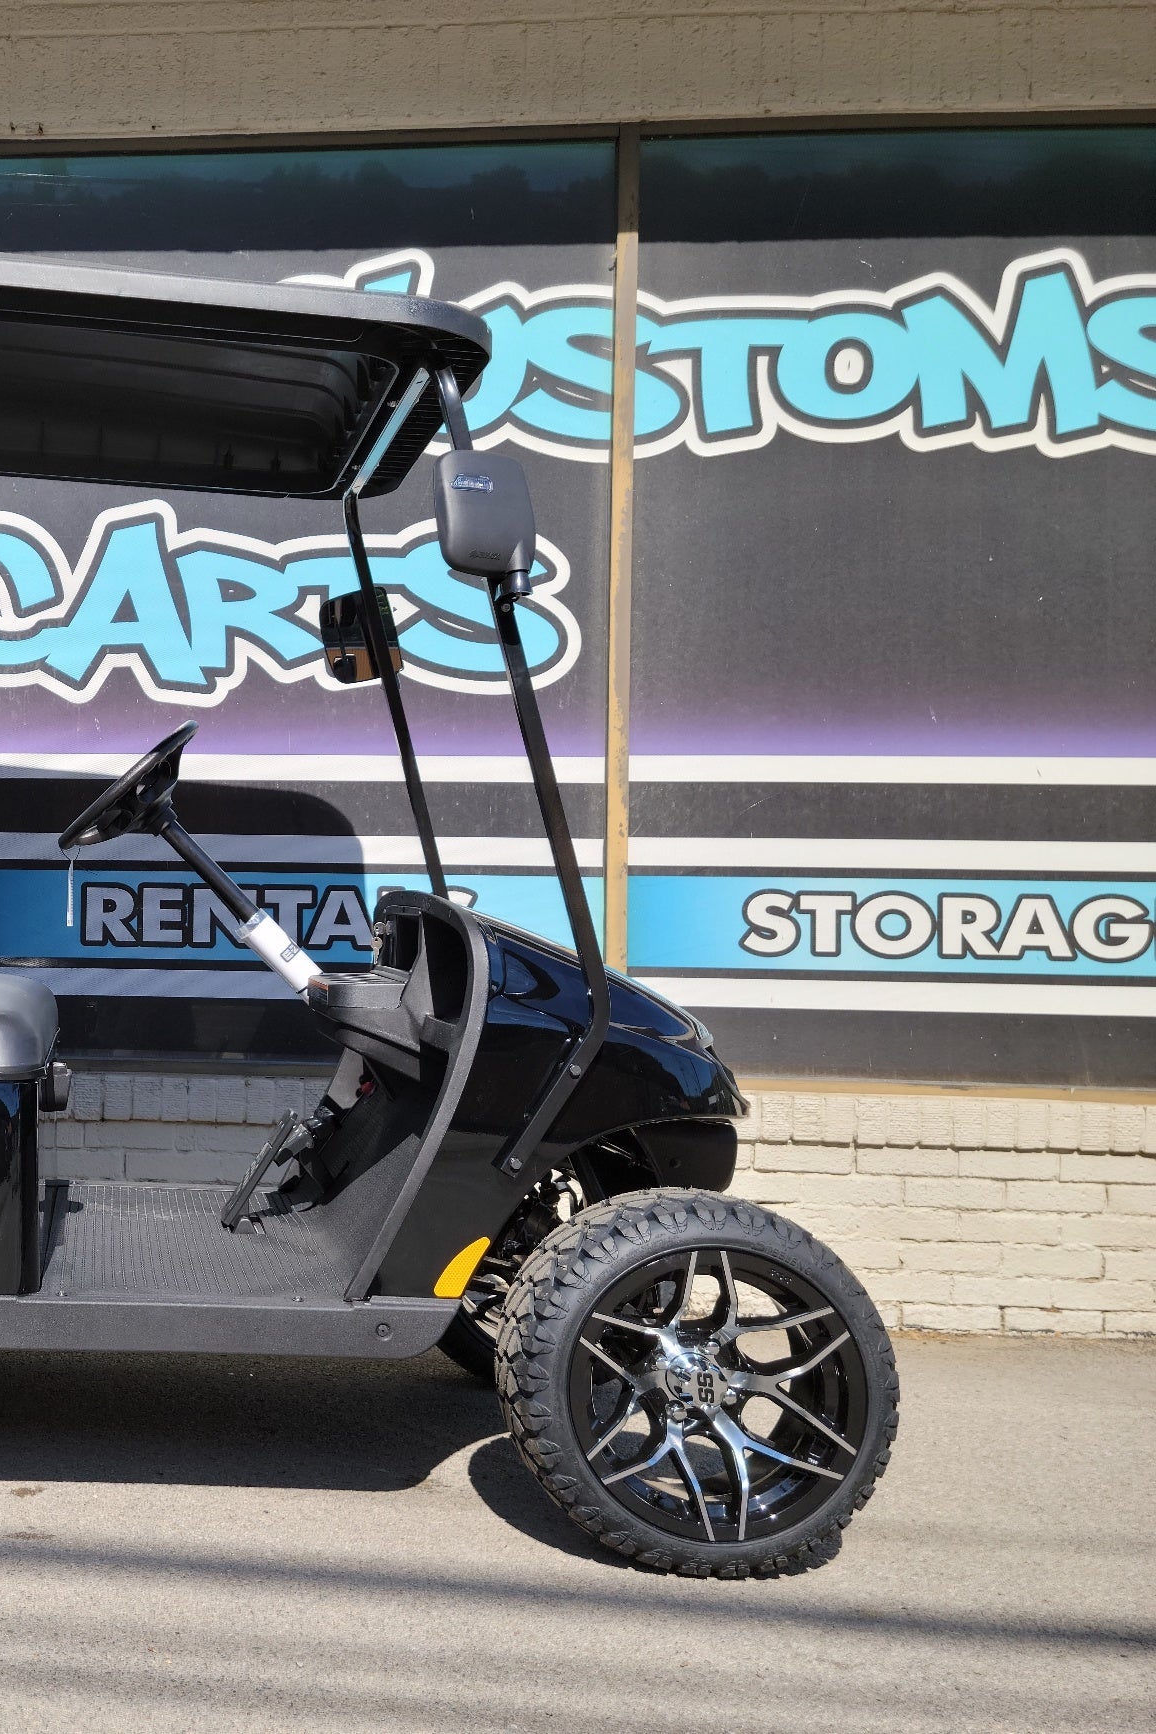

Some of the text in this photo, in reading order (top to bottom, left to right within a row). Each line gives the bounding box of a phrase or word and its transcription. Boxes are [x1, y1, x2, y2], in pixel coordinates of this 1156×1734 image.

[83, 884, 476, 947] RENTA
[743, 891, 1156, 962] STORAG
[696, 1371, 715, 1404] SS
